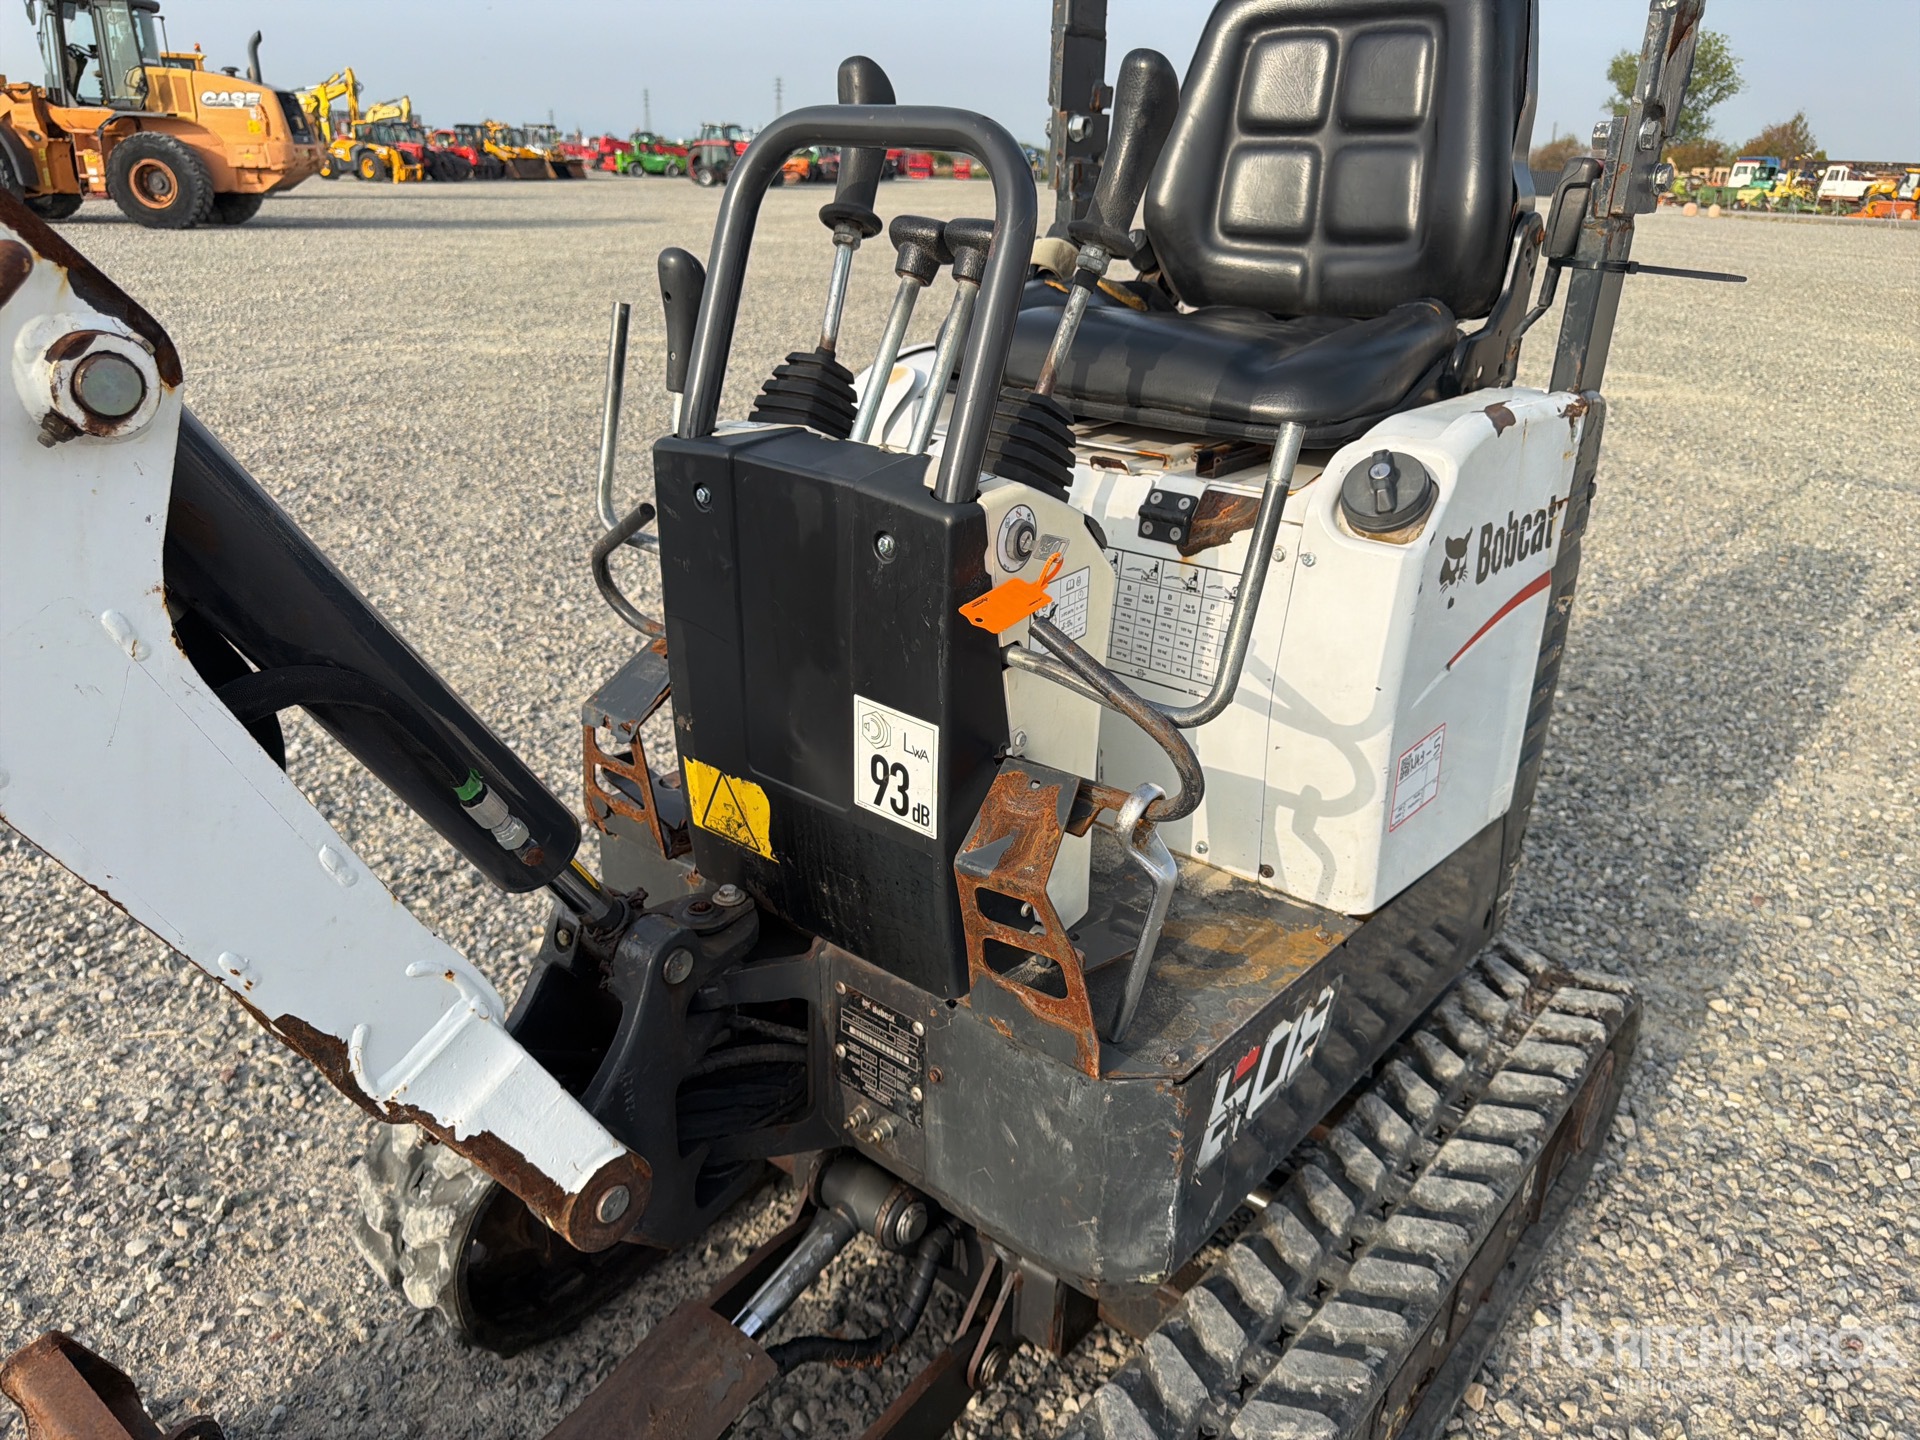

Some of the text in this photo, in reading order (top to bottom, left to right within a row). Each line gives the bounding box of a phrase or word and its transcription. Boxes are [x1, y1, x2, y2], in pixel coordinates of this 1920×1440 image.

[201, 91, 261, 107] CASE
[1475, 494, 1563, 585] Bobcat
[870, 753, 931, 827] 93 dB
